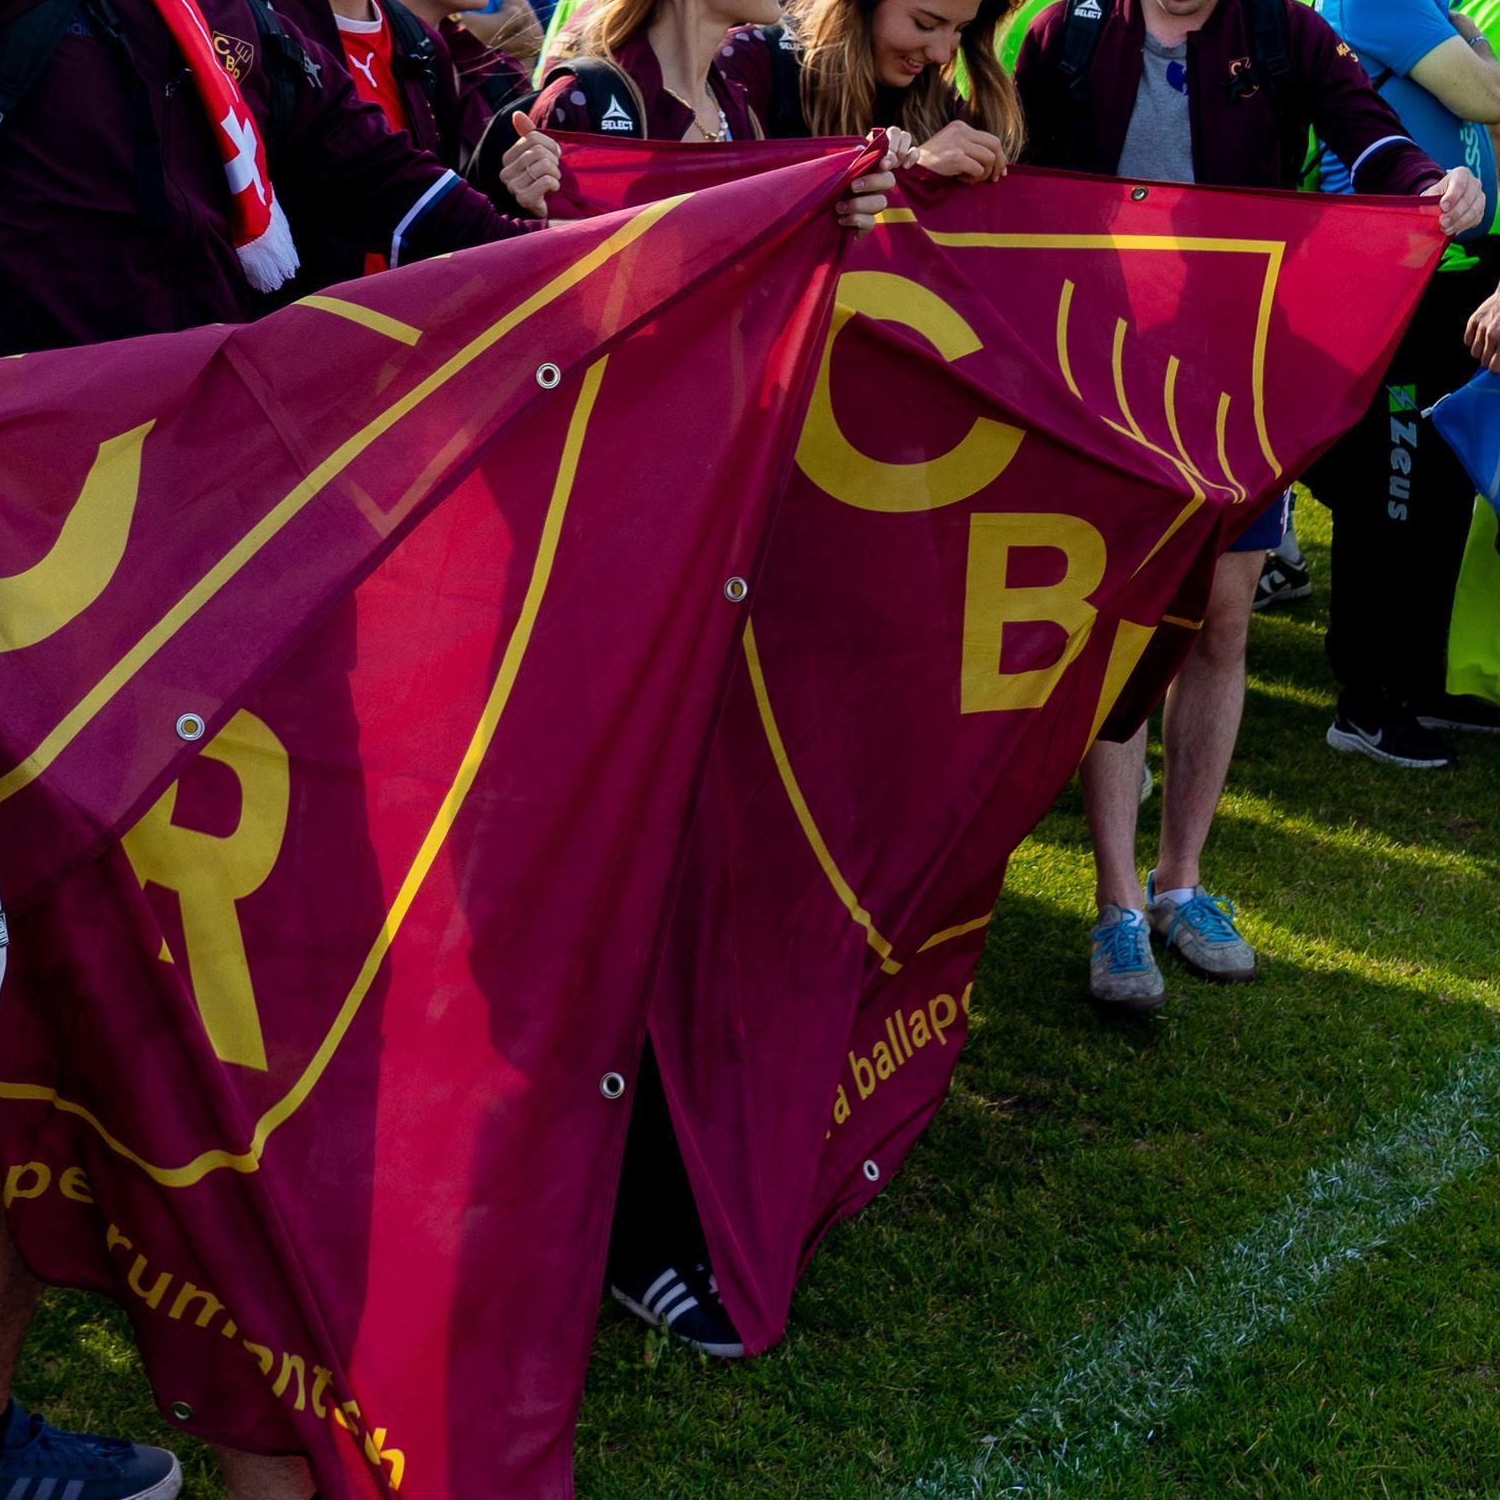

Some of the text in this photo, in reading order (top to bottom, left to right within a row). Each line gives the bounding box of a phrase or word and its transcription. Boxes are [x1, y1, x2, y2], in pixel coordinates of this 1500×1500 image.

[1074, 8, 1103, 20] SELECT
[213, 36, 230, 55] C
[225, 55, 236, 72] B
[601, 120, 634, 131] SELECT
[795, 270, 1027, 513] C
[1387, 416, 1418, 521] Zeus
[960, 512, 1108, 714] B
[121, 708, 290, 1071] R
